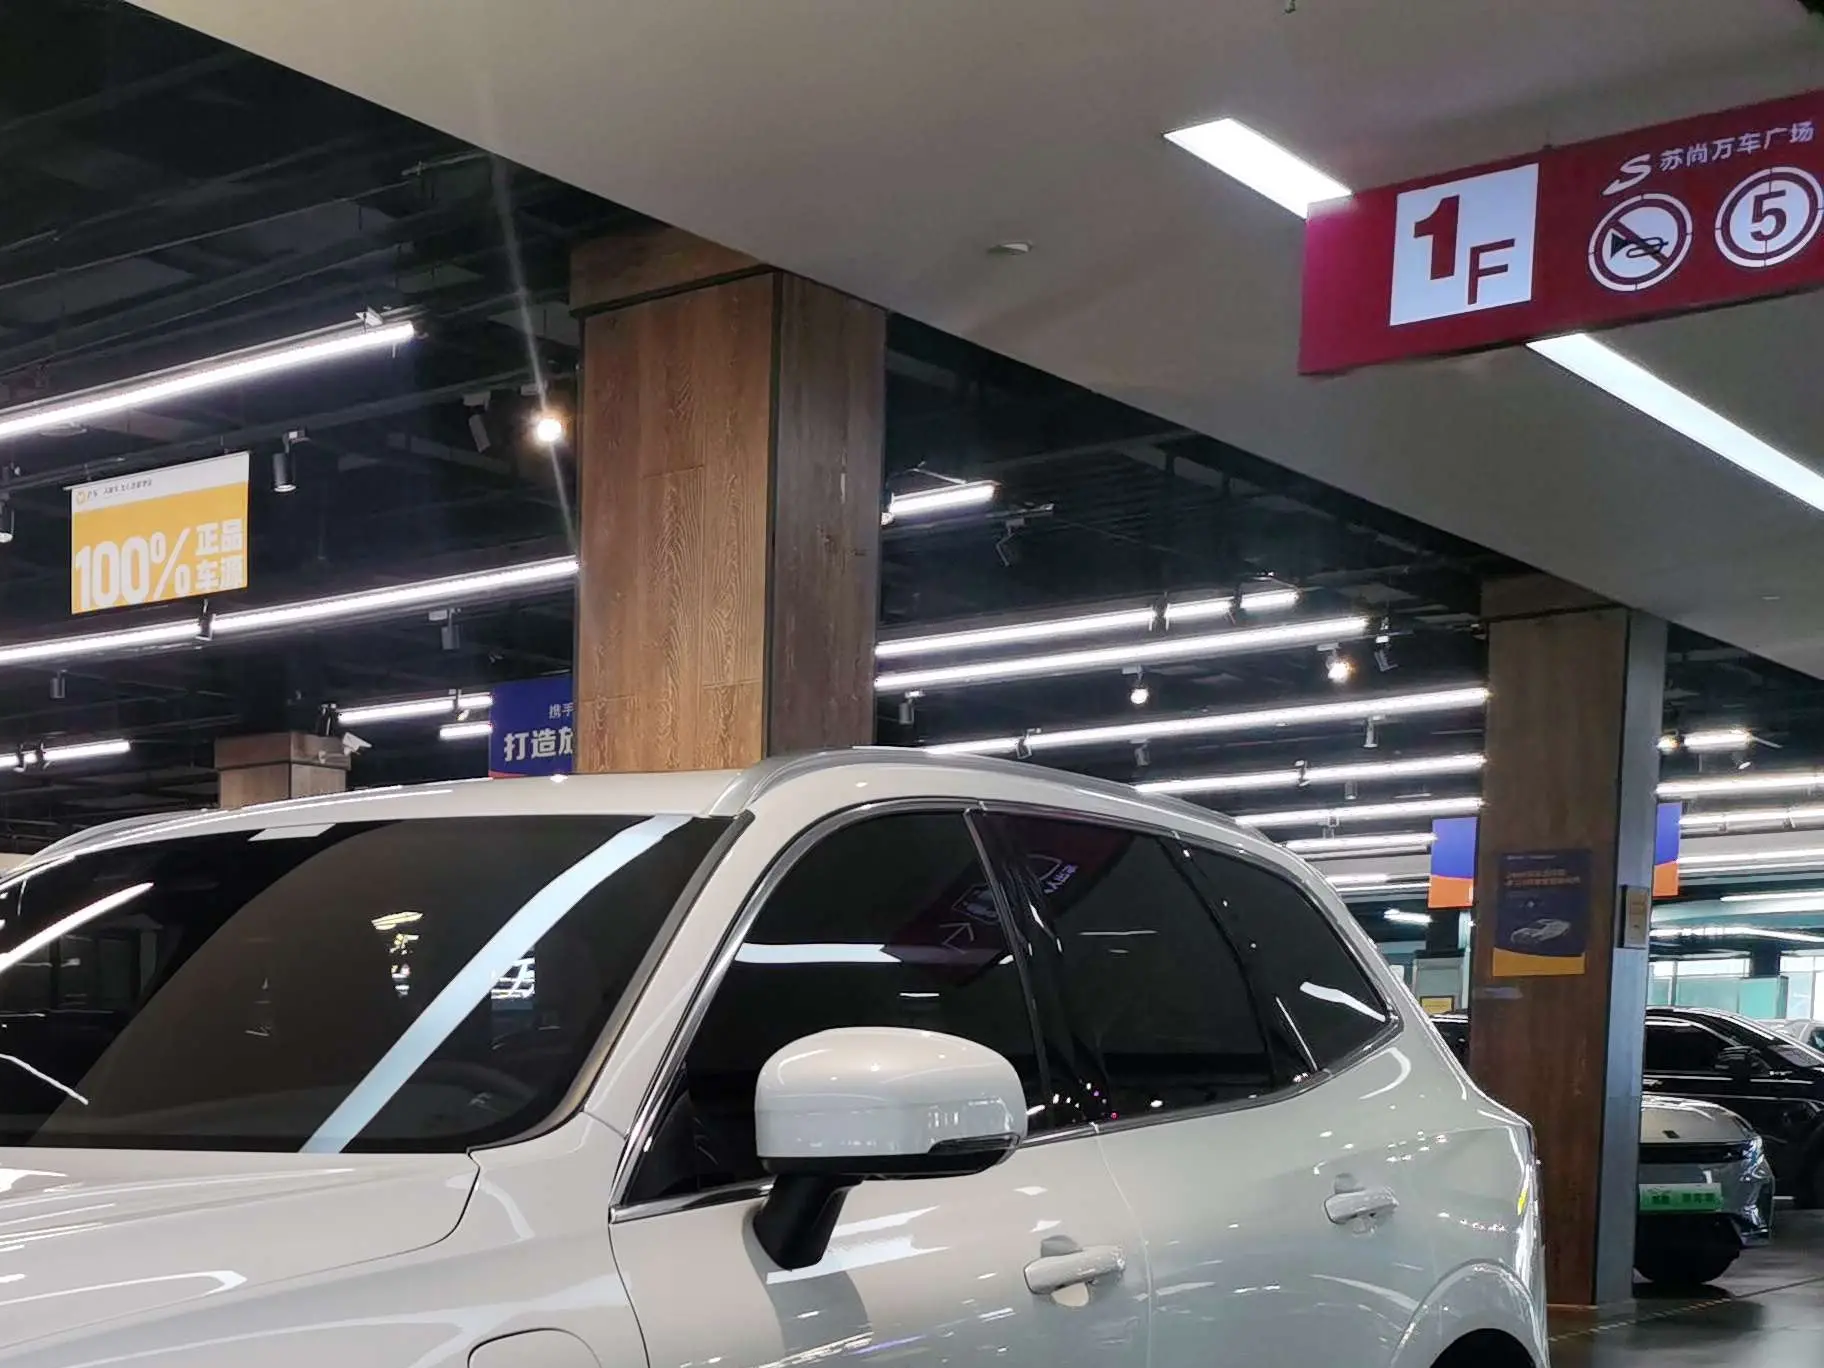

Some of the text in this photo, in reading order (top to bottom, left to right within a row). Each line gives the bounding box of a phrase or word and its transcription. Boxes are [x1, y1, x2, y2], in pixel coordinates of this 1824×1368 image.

[1658, 121, 1814, 171] 苏尚万车广场
[1750, 189, 1787, 242] 5
[75, 527, 191, 608] 100%
